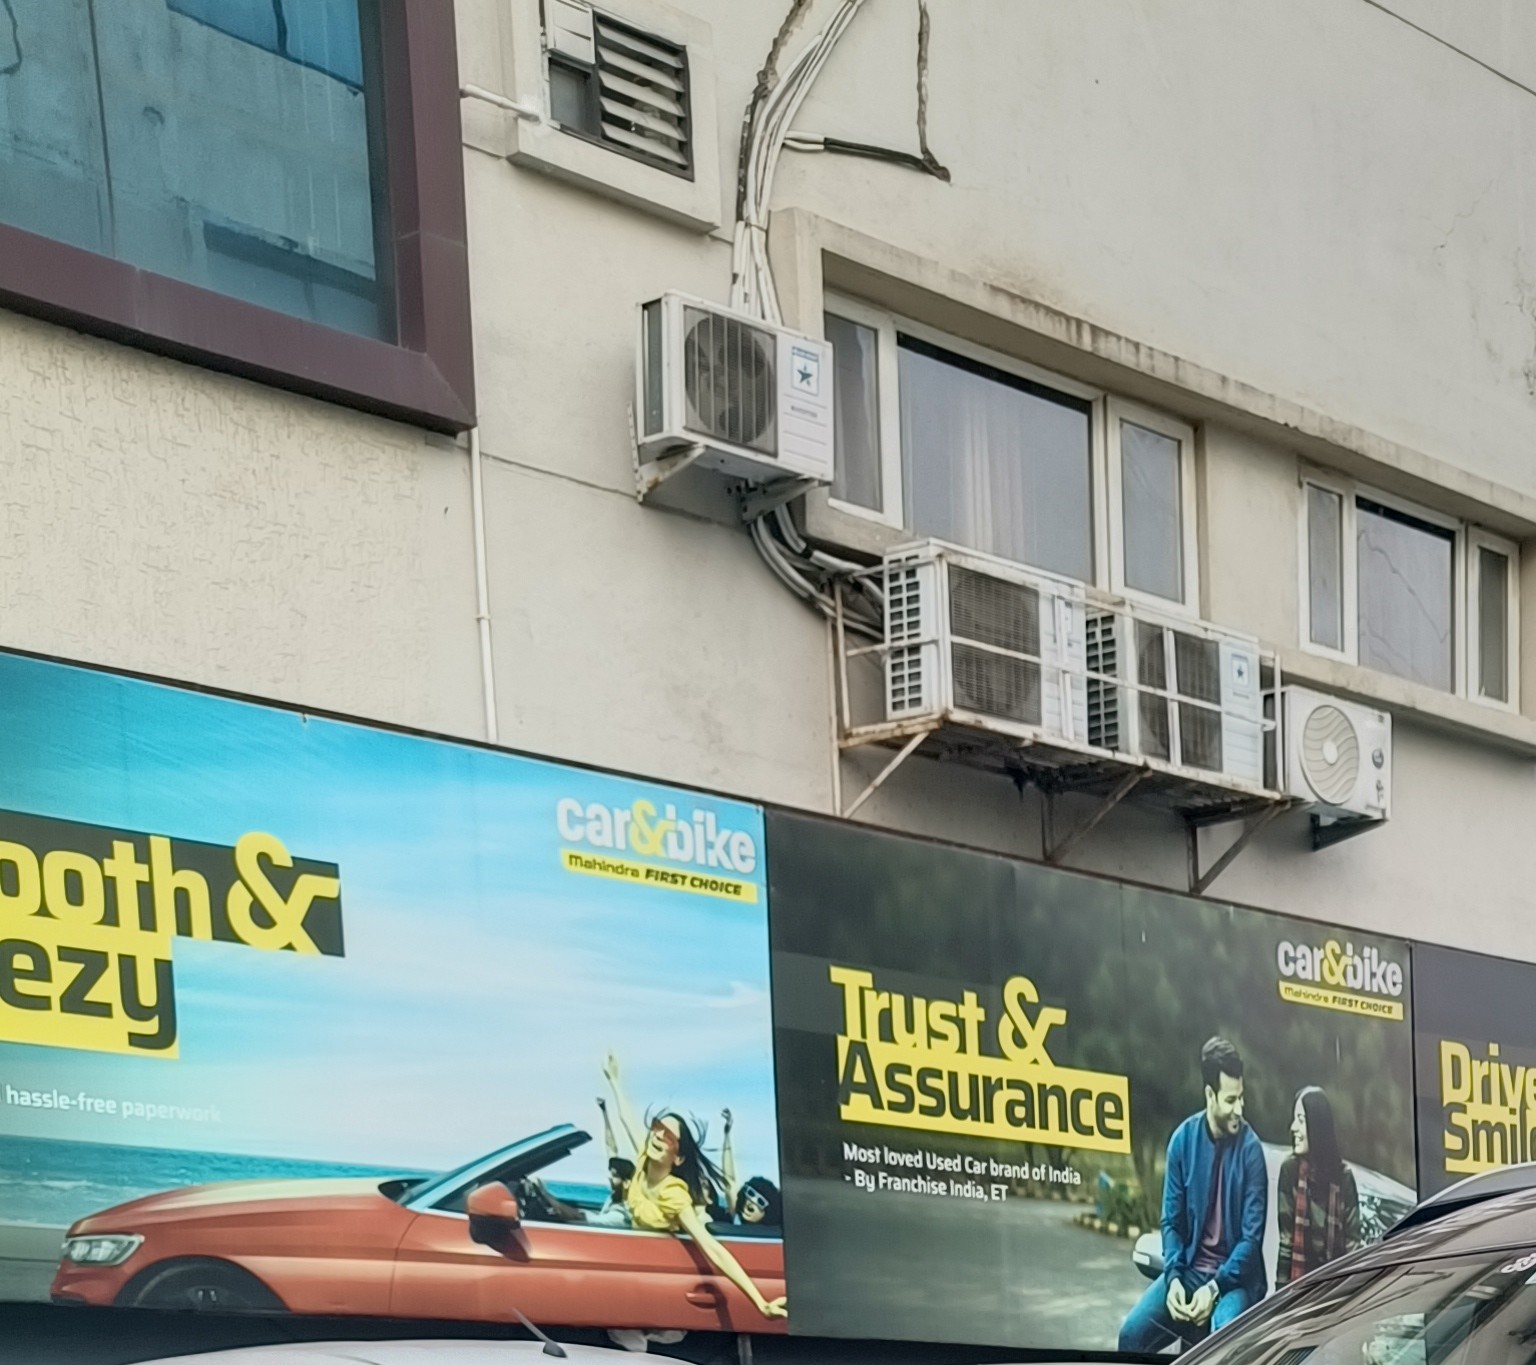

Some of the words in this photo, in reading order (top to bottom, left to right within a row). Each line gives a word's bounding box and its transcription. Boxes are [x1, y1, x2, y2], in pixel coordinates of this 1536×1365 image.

[557, 798, 756, 873] car&bike
[227, 831, 341, 955] &
[568, 854, 639, 877] Mahindra
[645, 868, 687, 886] FIRST
[689, 876, 742, 896] CHOICE
[0, 938, 177, 1050] ezy
[1277, 940, 1403, 997] car&bike
[830, 965, 985, 1056] Trust
[998, 976, 1067, 1067] &
[1332, 995, 1359, 1009] FIRST
[1360, 1000, 1393, 1015] CHOICE
[6, 1084, 116, 1115] hassle-free
[122, 1101, 222, 1123] paperwork
[840, 1038, 1124, 1140] Assurance
[843, 1141, 881, 1165] Most
[884, 1145, 923, 1169] loved
[926, 1152, 962, 1174] Used
[964, 1155, 987, 1176] Car
[990, 1157, 1030, 1180] brand
[1031, 1163, 1047, 1182] of
[1049, 1166, 1082, 1186] India
[854, 1169, 875, 1193] By
[878, 1172, 947, 1196] Franchise
[950, 1180, 988, 1202] India,
[991, 1184, 1009, 1202] ET
